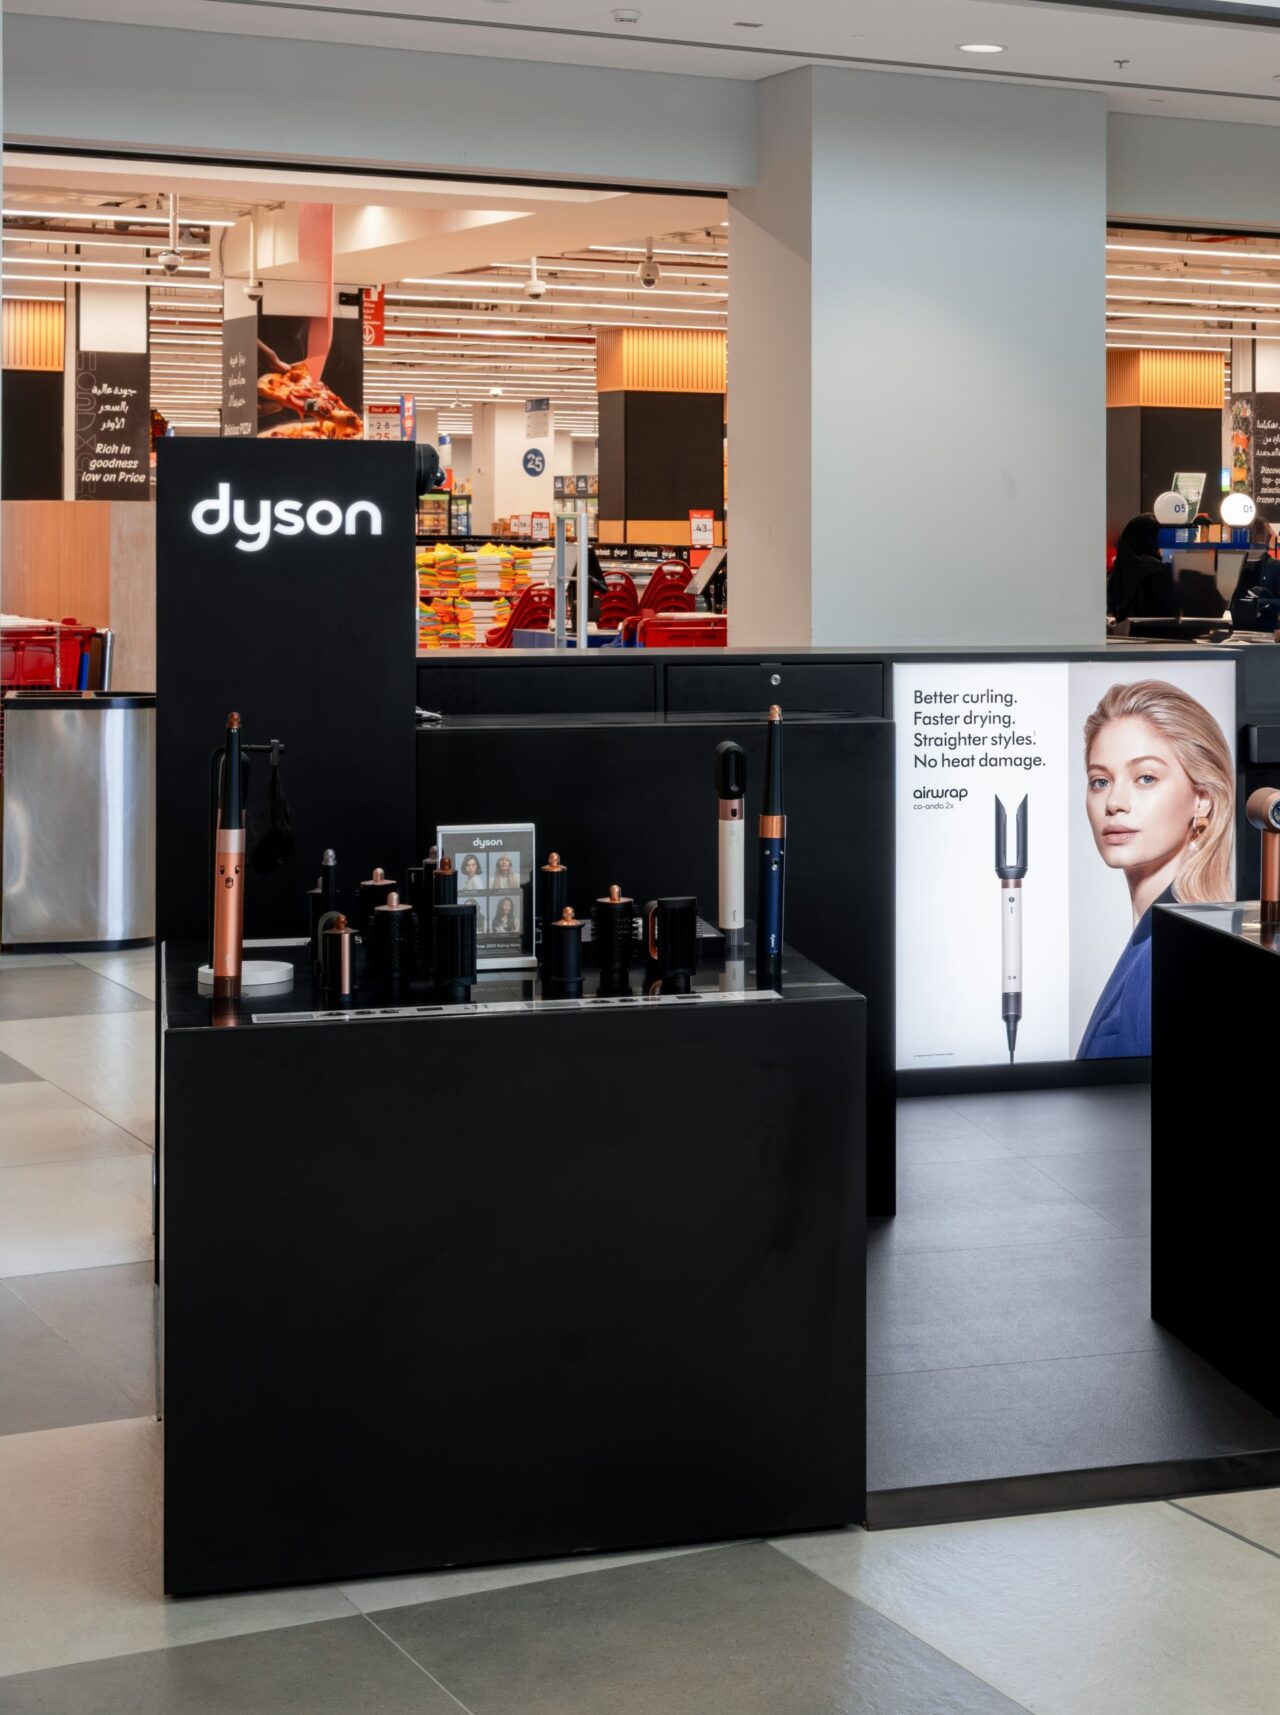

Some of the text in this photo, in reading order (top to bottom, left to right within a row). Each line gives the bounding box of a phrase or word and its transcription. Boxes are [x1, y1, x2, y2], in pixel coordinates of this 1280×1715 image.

[98, 401, 129, 414] بالسعر
[95, 443, 131, 455] Rich in
[89, 458, 139, 470] goodness
[526, 454, 543, 472] 25
[81, 472, 146, 483] low on Price
[1256, 496, 1275, 504] frozen
[1174, 504, 1186, 513] 05
[191, 482, 382, 552] dyson
[695, 523, 708, 533] 43
[914, 688, 1018, 707] Better curling.
[914, 710, 1016, 728] Faster drying.
[914, 732, 988, 750] Straighter
[914, 752, 1046, 770] No heat damage.
[913, 786, 968, 802] airwrap
[913, 802, 944, 810] co-anda
[472, 837, 503, 849] dyson
